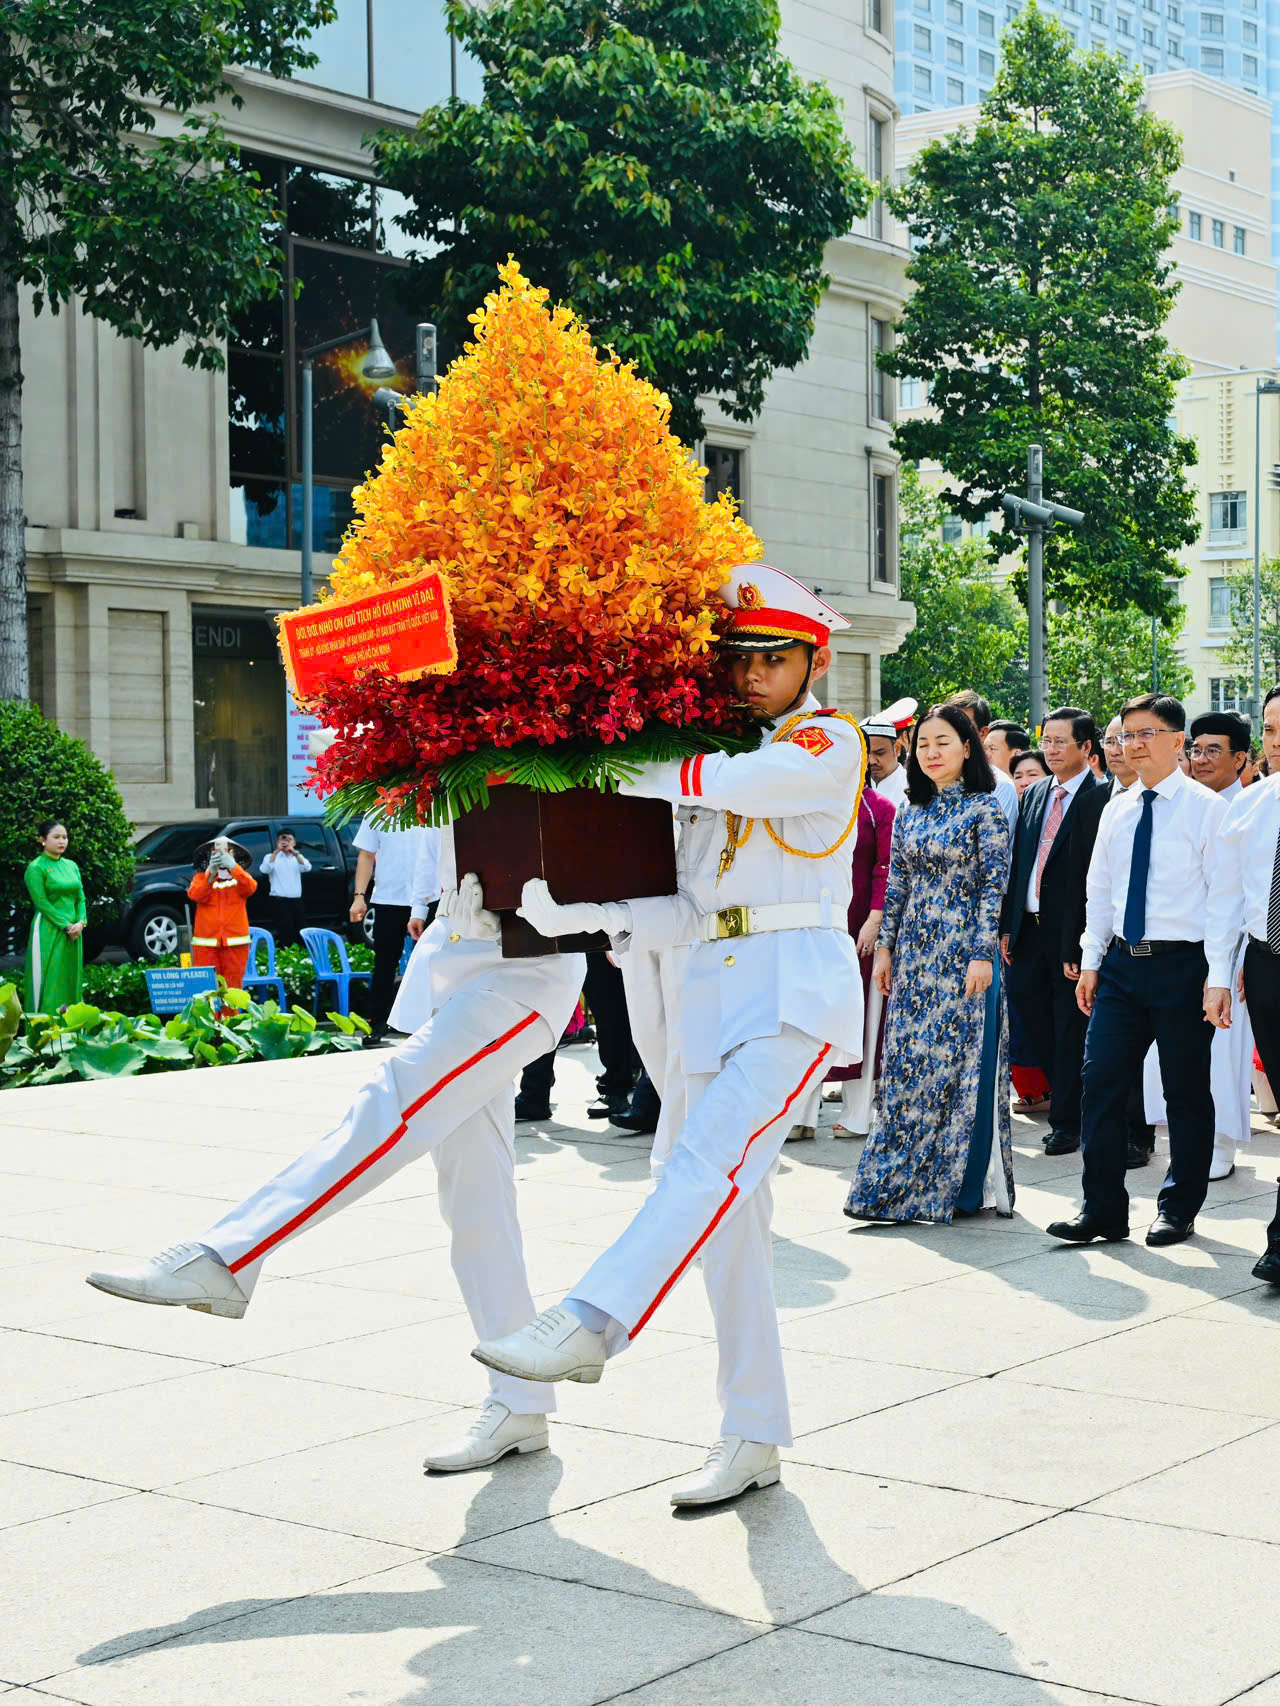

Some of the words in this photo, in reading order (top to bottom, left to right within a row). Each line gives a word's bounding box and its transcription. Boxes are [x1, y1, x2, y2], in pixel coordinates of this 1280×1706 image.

[392, 595, 412, 612] MINH
[193, 625, 241, 648] ENDI
[181, 970, 209, 979] (PLEASE)
